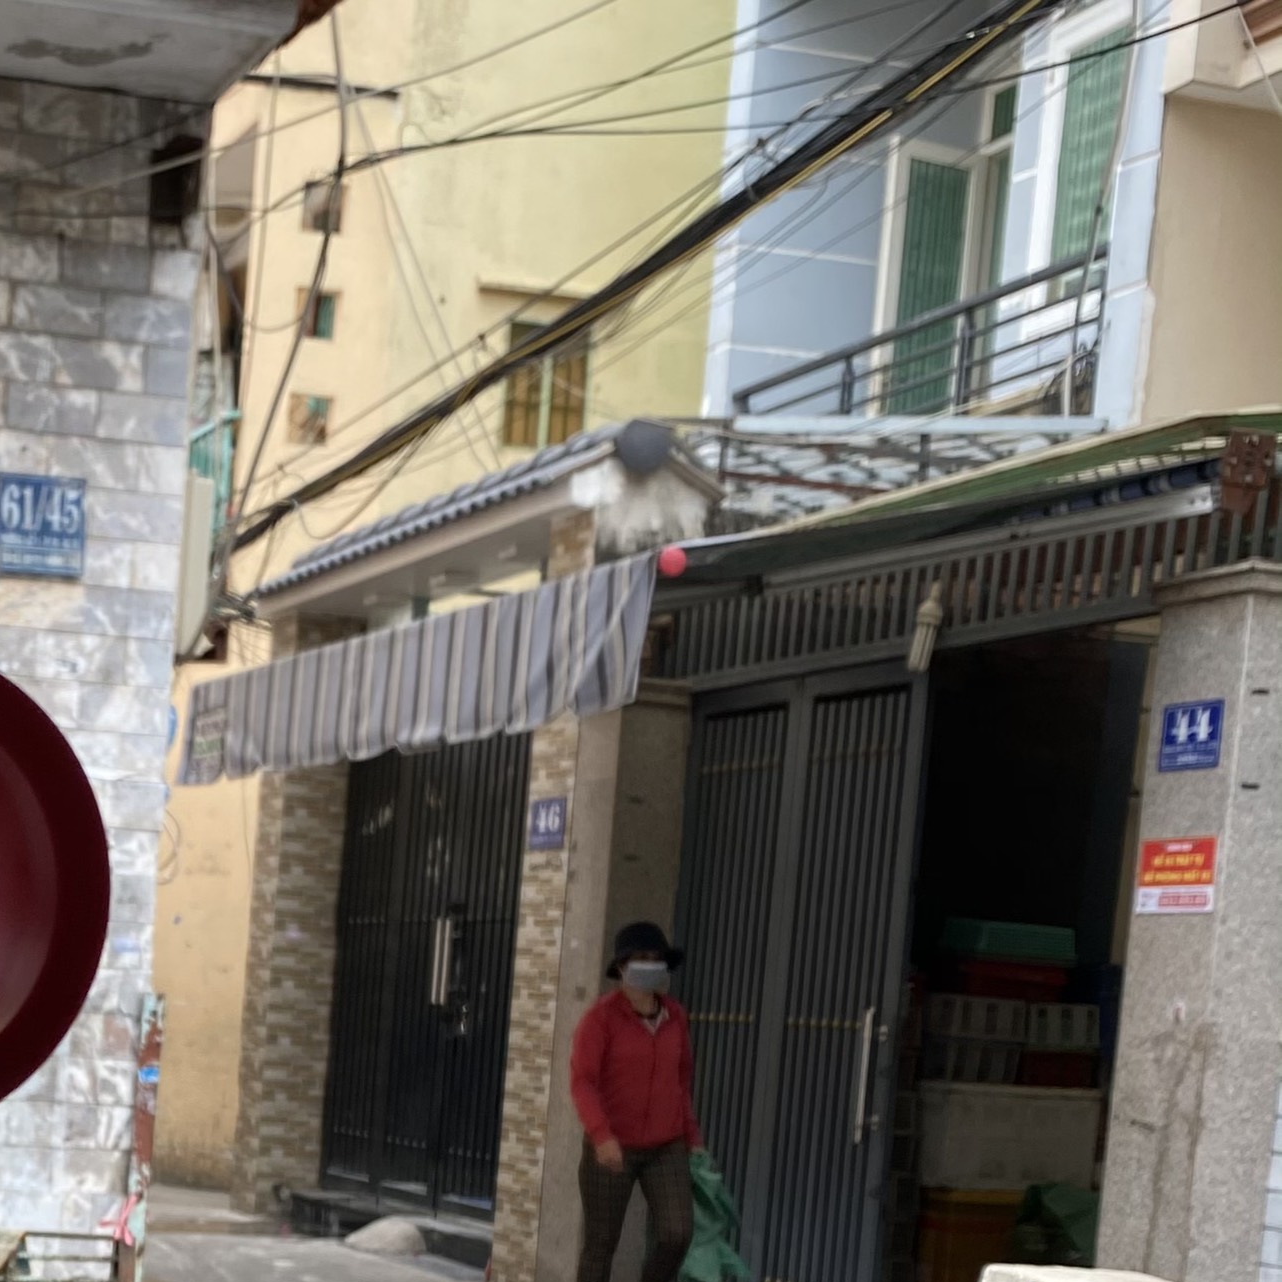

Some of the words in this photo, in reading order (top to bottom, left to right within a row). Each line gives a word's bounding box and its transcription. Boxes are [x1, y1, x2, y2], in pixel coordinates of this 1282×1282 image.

[0, 483, 81, 534] 61/45
[1171, 707, 1214, 743] 44
[536, 803, 561, 833] 46
